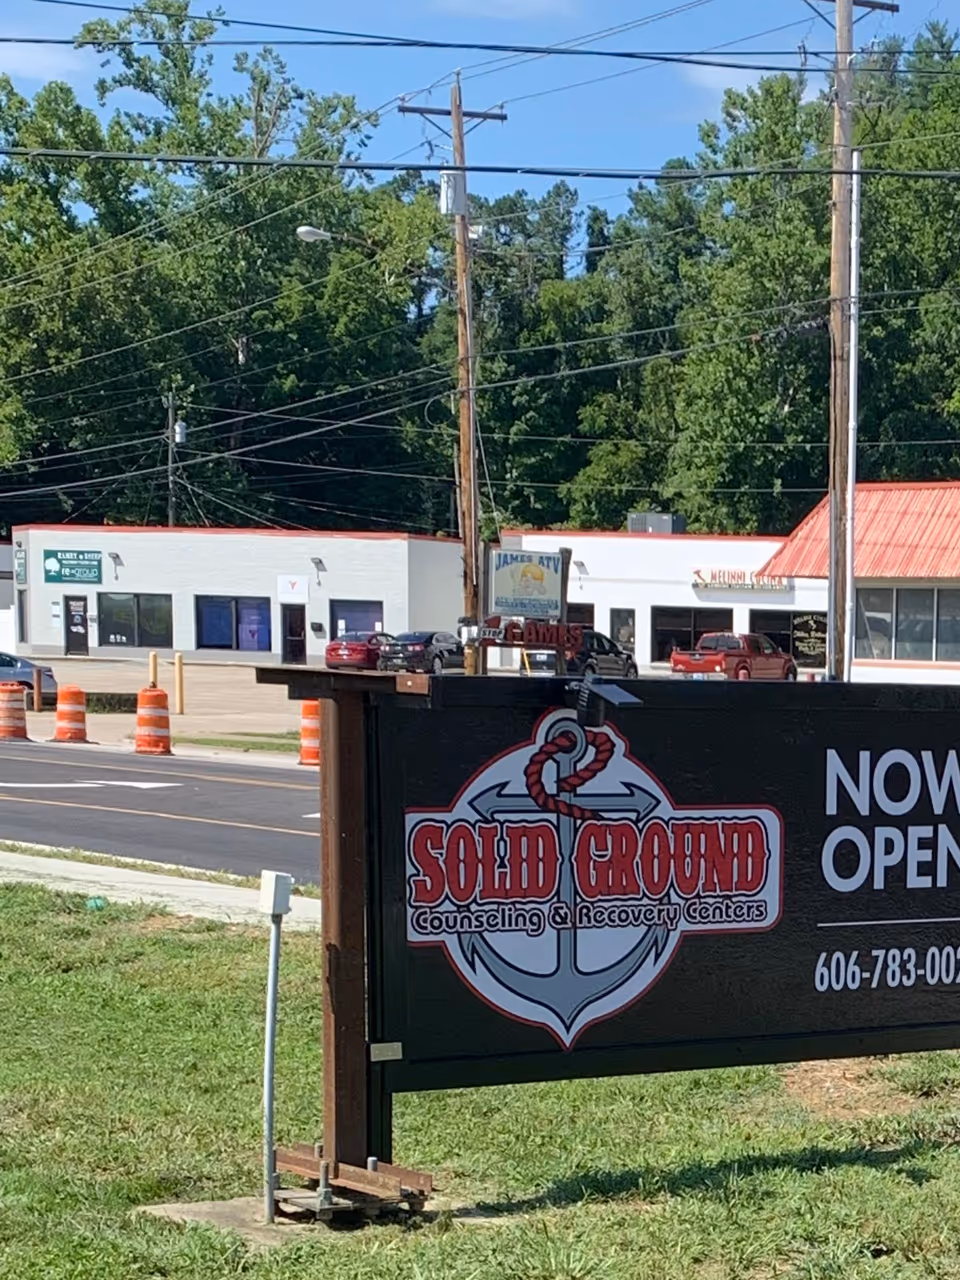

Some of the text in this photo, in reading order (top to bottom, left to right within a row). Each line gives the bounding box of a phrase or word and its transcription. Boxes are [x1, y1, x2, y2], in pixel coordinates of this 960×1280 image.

[495, 552, 561, 575] JAMES ATV
[411, 820, 769, 904] SOLID GROUND
[414, 900, 767, 935] Counseling & Recovery Centers
